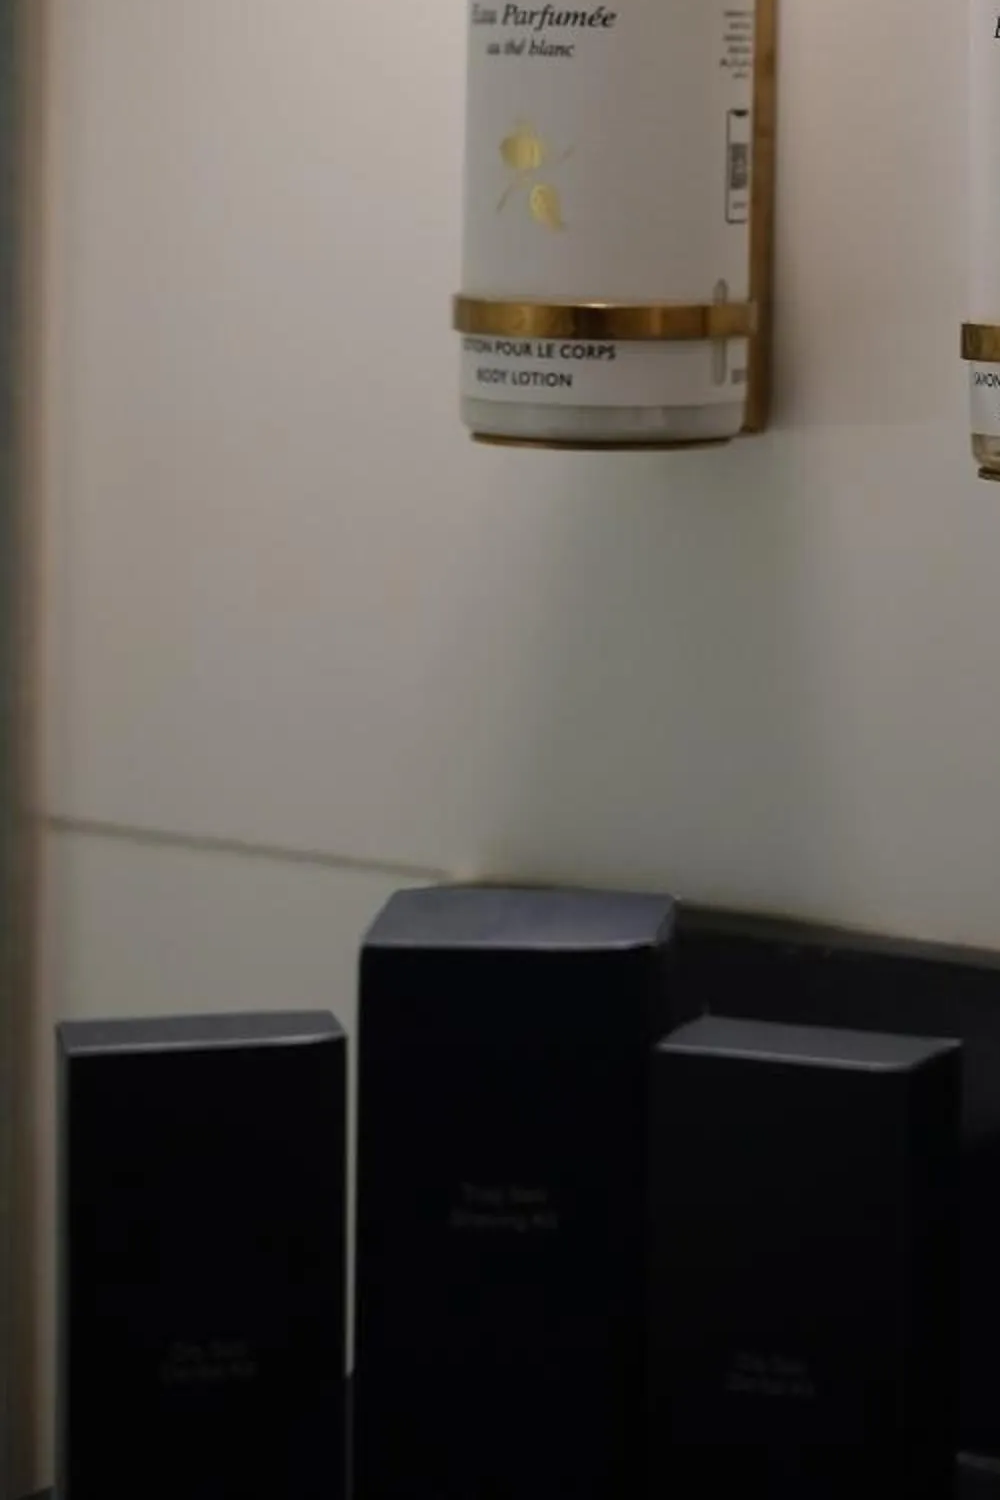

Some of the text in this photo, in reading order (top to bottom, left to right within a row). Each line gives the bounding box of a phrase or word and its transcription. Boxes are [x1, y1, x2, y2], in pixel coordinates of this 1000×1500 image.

[501, 3, 617, 31] Parfumée
[528, 40, 575, 58] blanc
[495, 340, 533, 357] POUR
[537, 342, 555, 359] LE
[559, 344, 617, 361] CORPS
[511, 371, 573, 388] LOTION
